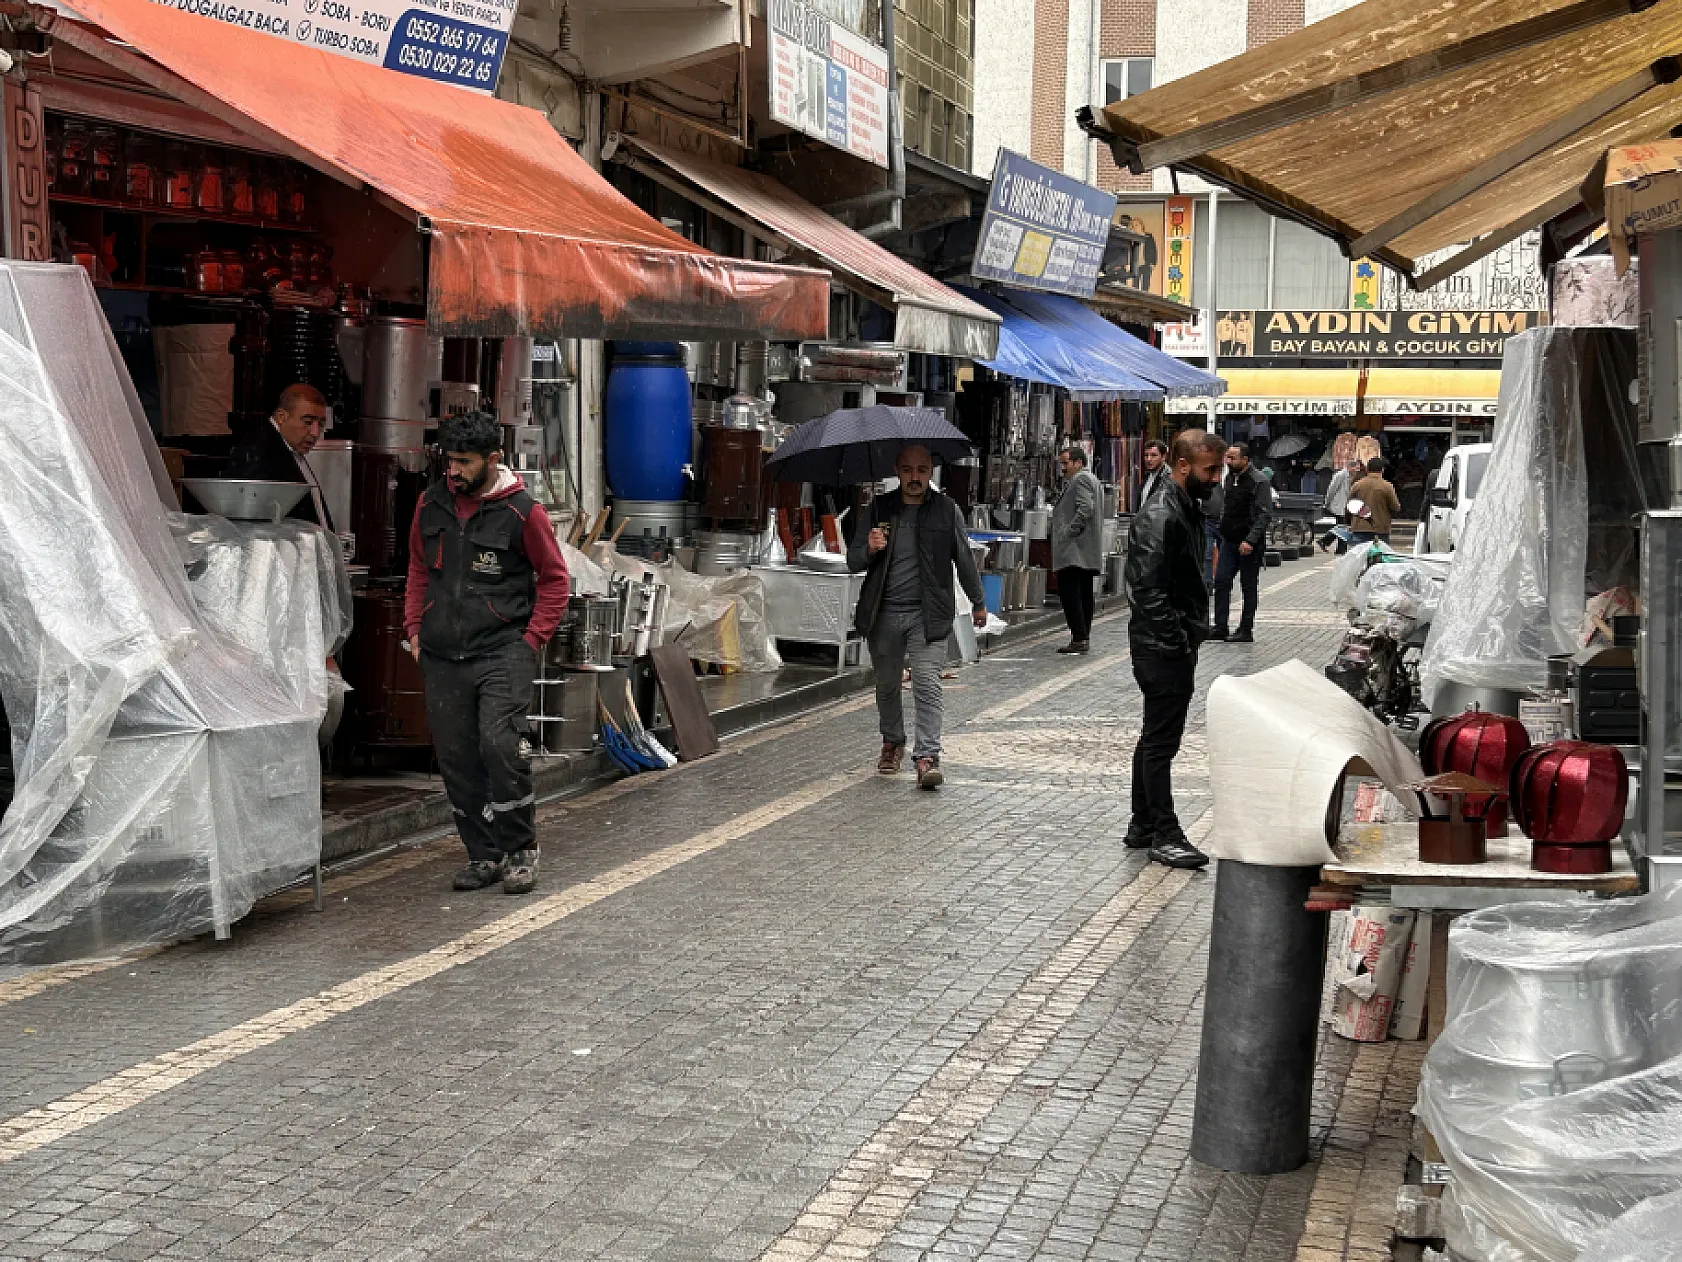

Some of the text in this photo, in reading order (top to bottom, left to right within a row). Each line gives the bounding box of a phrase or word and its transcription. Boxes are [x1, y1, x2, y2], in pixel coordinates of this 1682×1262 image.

[254, 13, 289, 35] BACA
[320, 1, 351, 22] SOBA
[361, 11, 392, 32] BORU
[314, 27, 379, 57] TURBO SOBA
[406, 17, 499, 57] 0552 865 97 64
[398, 43, 492, 83] 0530 029 22 65
[1264, 312, 1392, 334] AYDIN
[1270, 338, 1503, 355] BAY BAYAN & ÇOCUK GİYİ
[1265, 401, 1328, 413] GİYİM
[1396, 402, 1473, 413] AYDIN
